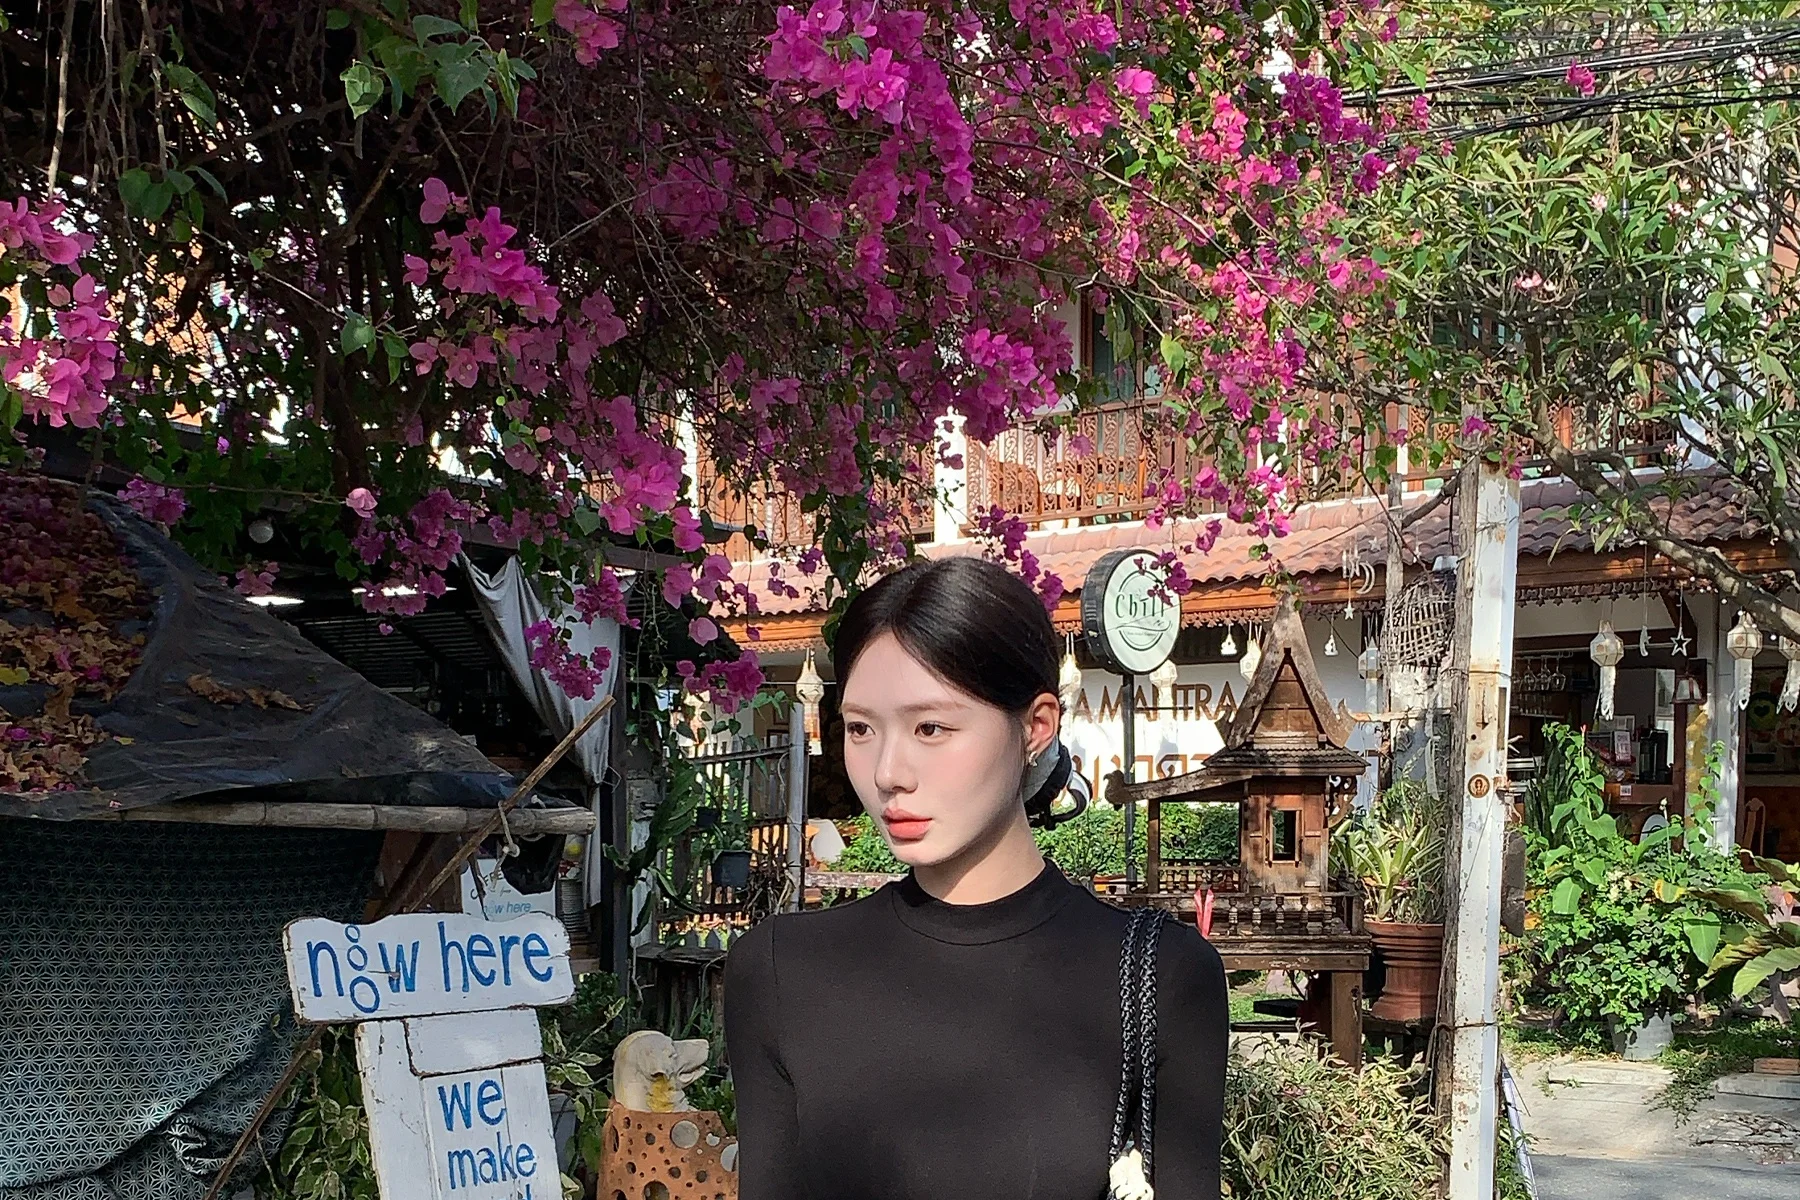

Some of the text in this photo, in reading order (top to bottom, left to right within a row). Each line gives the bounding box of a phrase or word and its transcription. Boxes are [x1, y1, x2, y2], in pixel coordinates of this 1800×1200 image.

[506, 900, 532, 914] here
[437, 920, 554, 993] here
[437, 1078, 507, 1132] we
[447, 1131, 537, 1190] make
